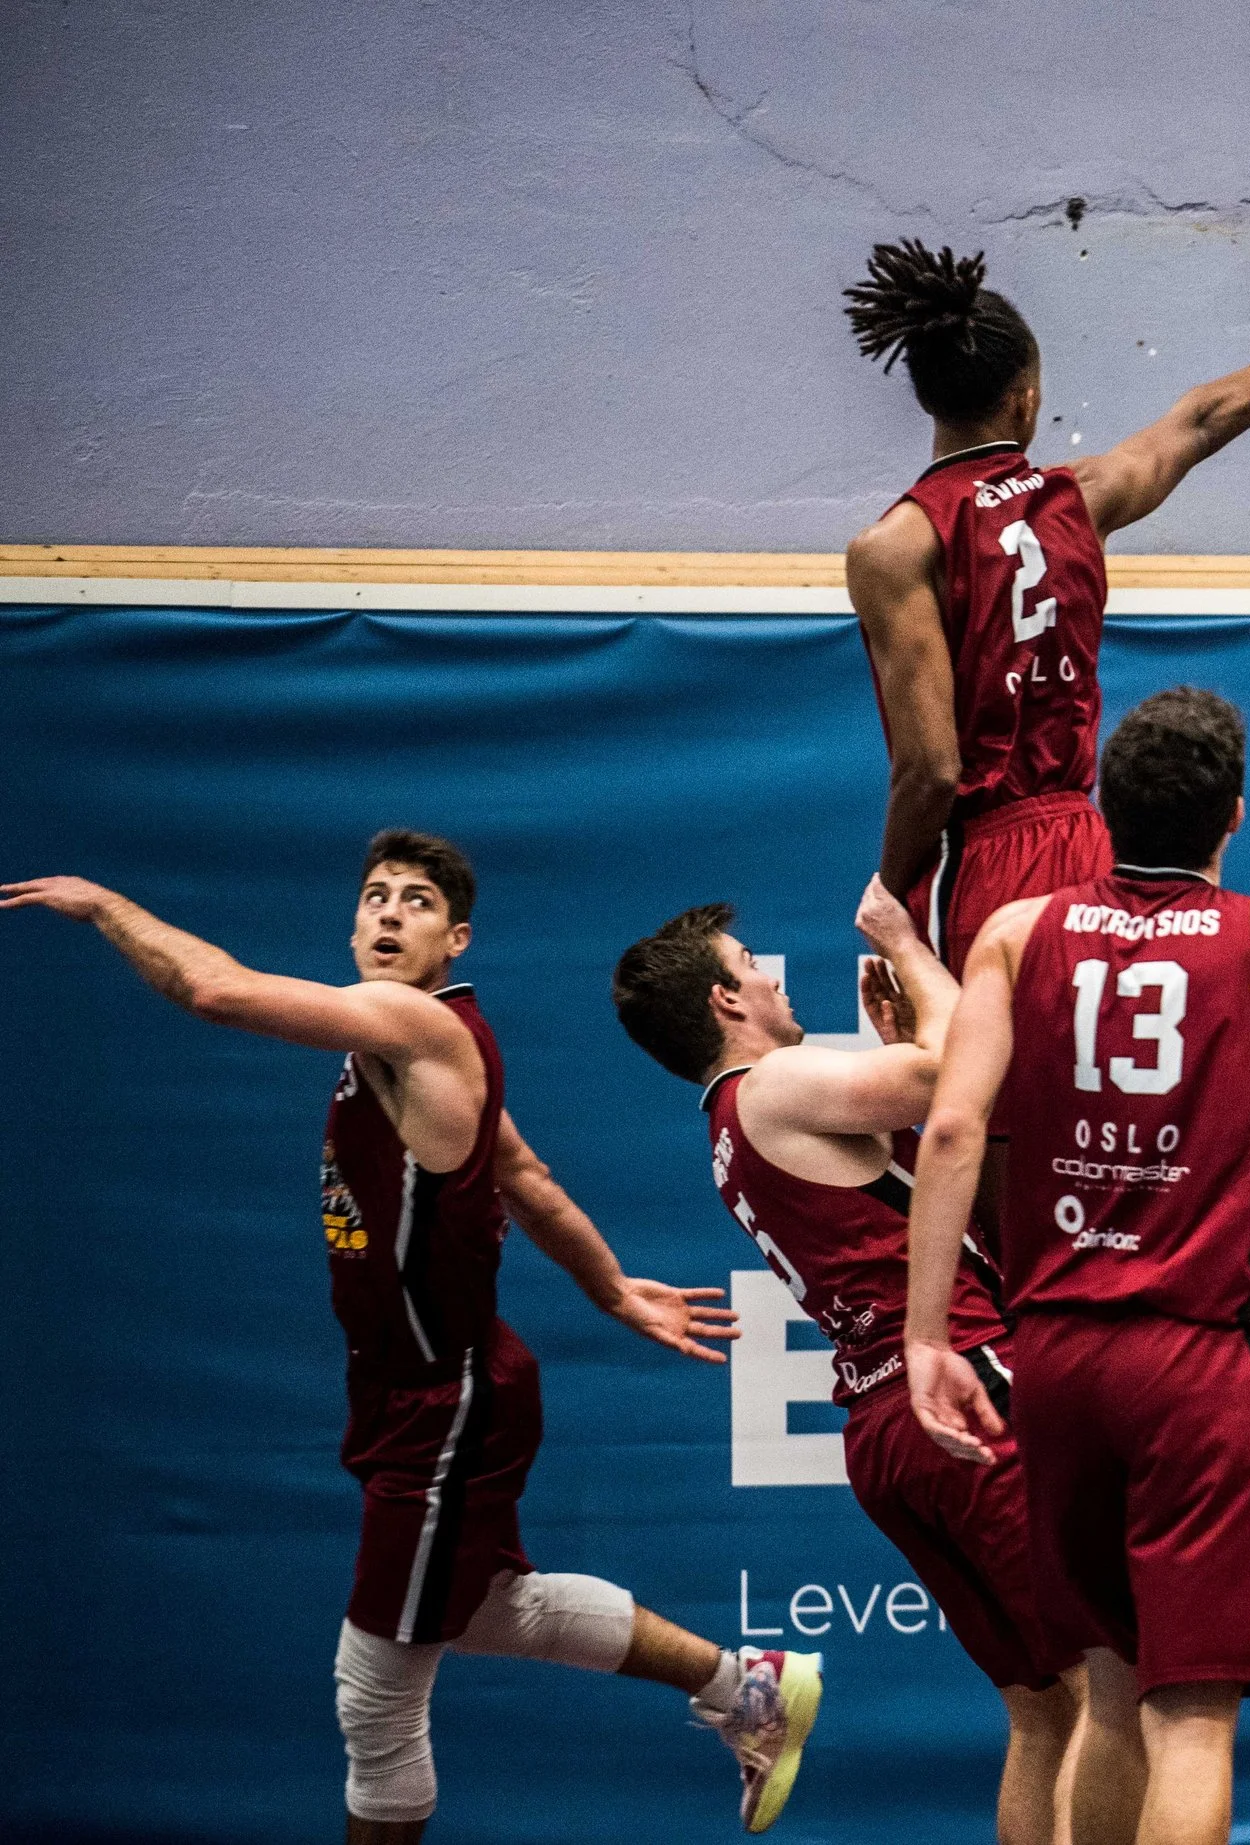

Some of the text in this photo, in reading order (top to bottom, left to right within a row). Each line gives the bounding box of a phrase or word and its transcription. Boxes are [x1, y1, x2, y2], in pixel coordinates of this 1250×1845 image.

[998, 519, 1057, 643] 2
[1072, 957, 1189, 1095] 13
[1075, 1118, 1180, 1154] OSLO
